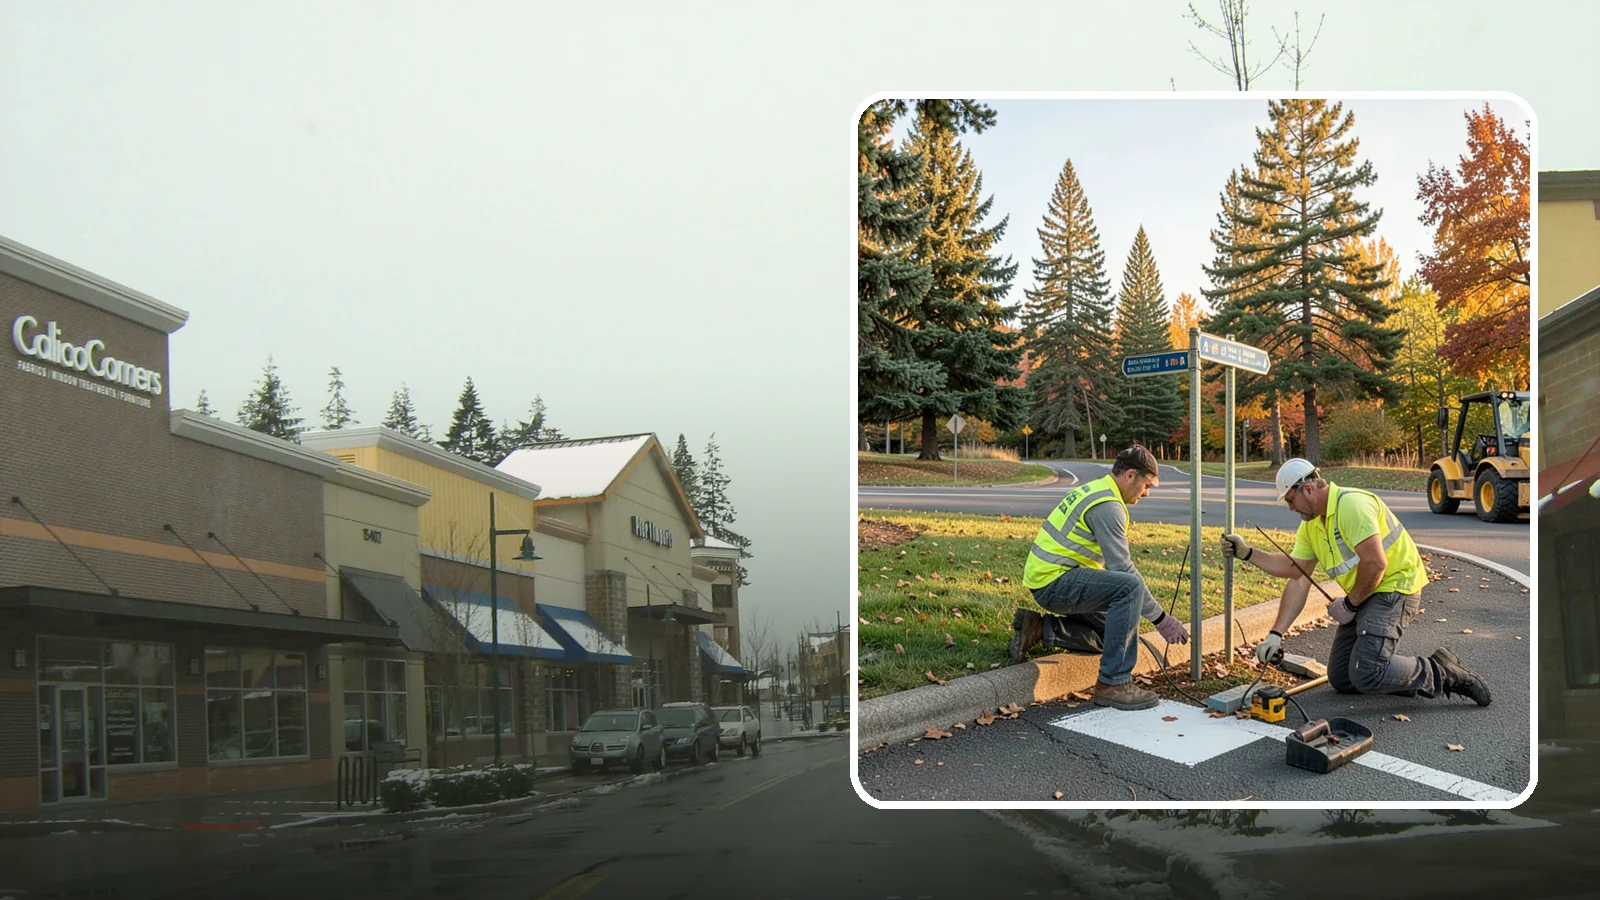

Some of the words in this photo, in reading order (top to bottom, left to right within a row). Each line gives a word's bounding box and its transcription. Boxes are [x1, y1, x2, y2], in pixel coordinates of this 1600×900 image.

[17, 360, 47, 377] FABRICS
[51, 369, 78, 387] WINDOW
[78, 378, 116, 398] TREATMENTS
[120, 391, 151, 408] FURNITURE
